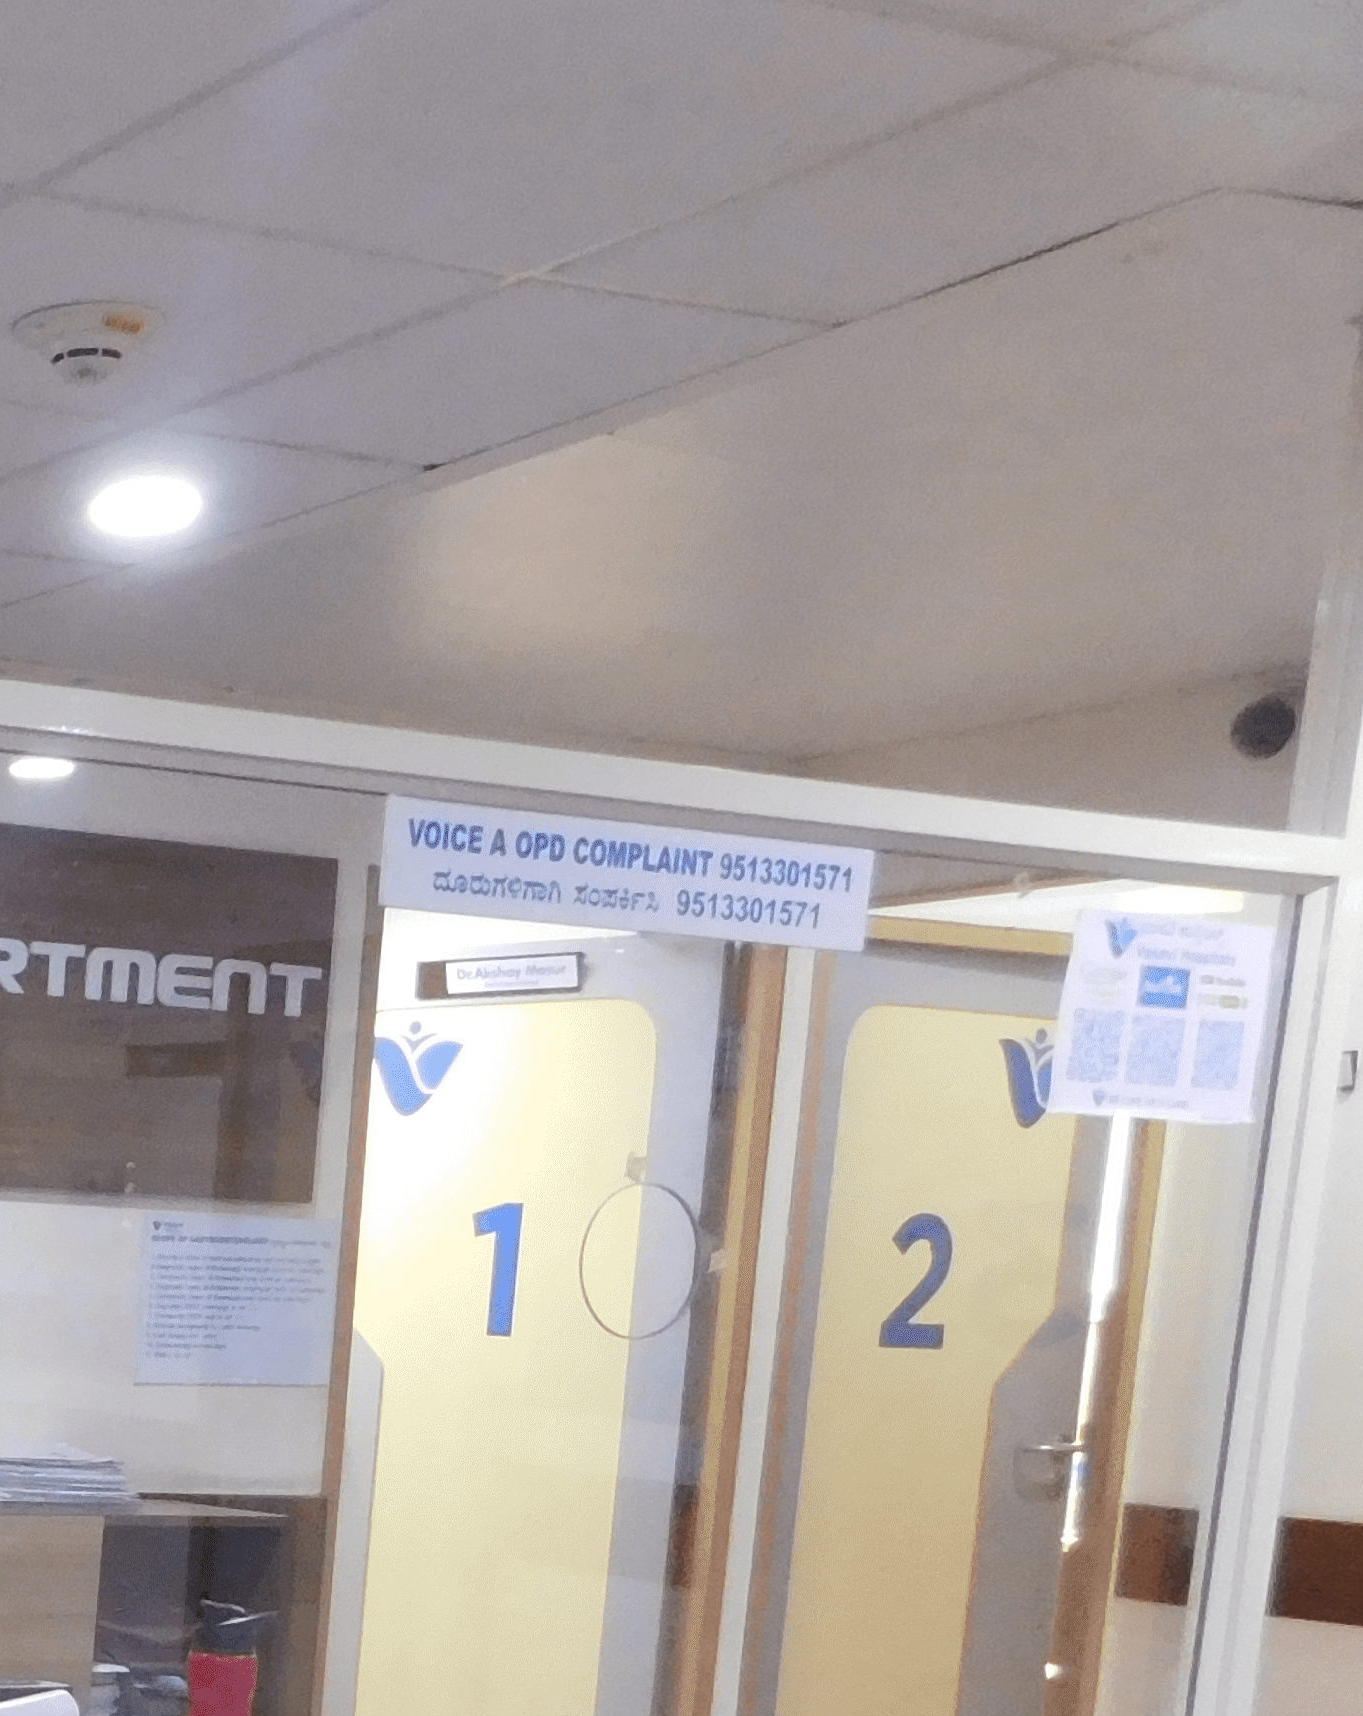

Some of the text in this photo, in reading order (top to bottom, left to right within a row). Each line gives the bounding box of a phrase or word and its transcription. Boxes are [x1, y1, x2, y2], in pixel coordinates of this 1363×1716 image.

[407, 817, 855, 894] VOICE A OPD COMPLAINT 9513301571
[675, 889, 821, 931] 9513301571
[472, 1202, 525, 1338] 1
[878, 1212, 953, 1349] 2
